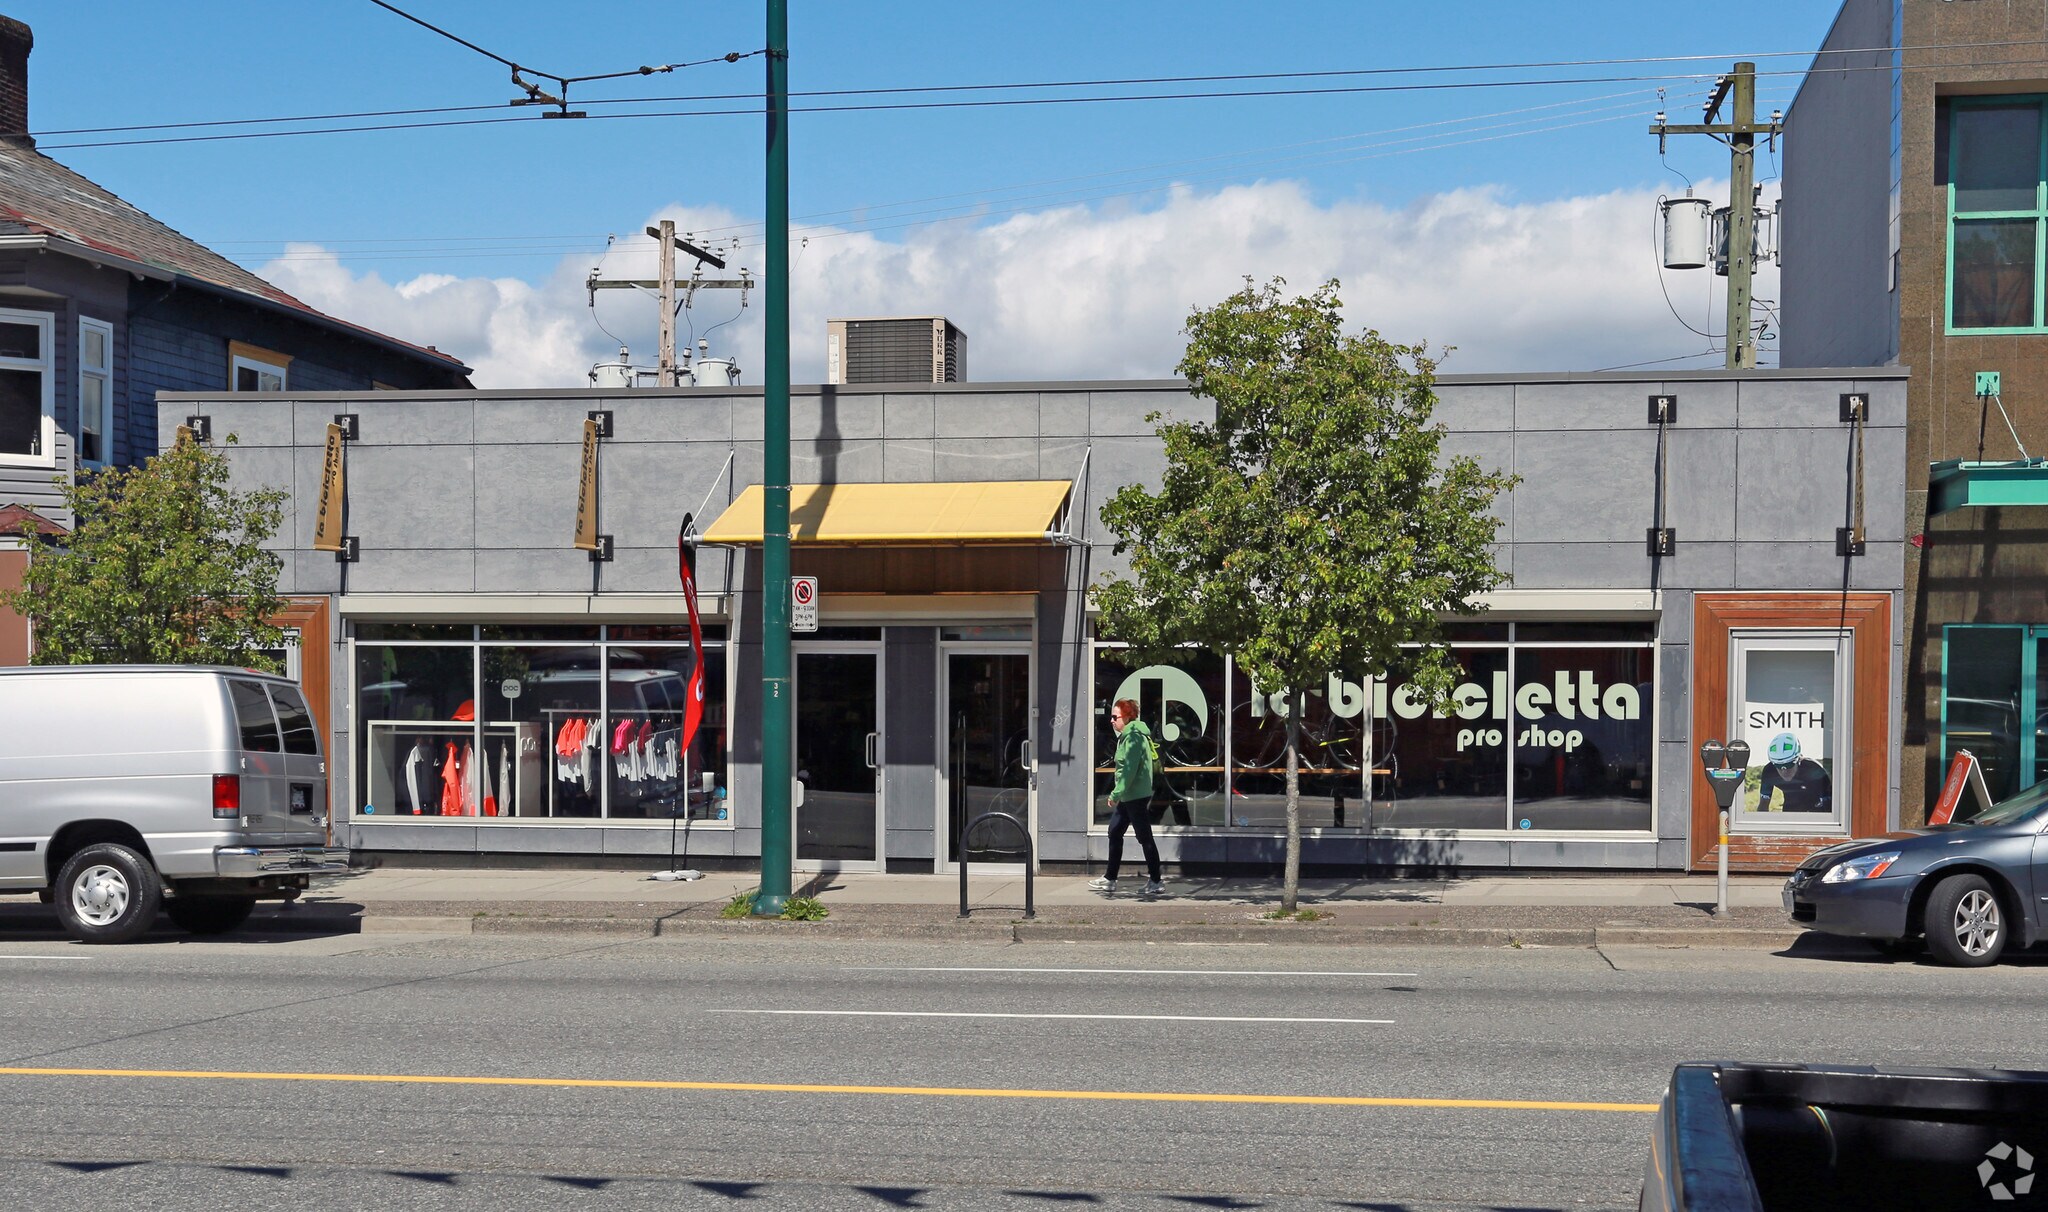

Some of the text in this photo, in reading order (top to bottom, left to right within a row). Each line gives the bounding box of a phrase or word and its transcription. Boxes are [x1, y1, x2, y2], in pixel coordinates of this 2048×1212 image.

[1749, 711, 1825, 729] SMITH
[1457, 724, 1583, 753] pro shop
